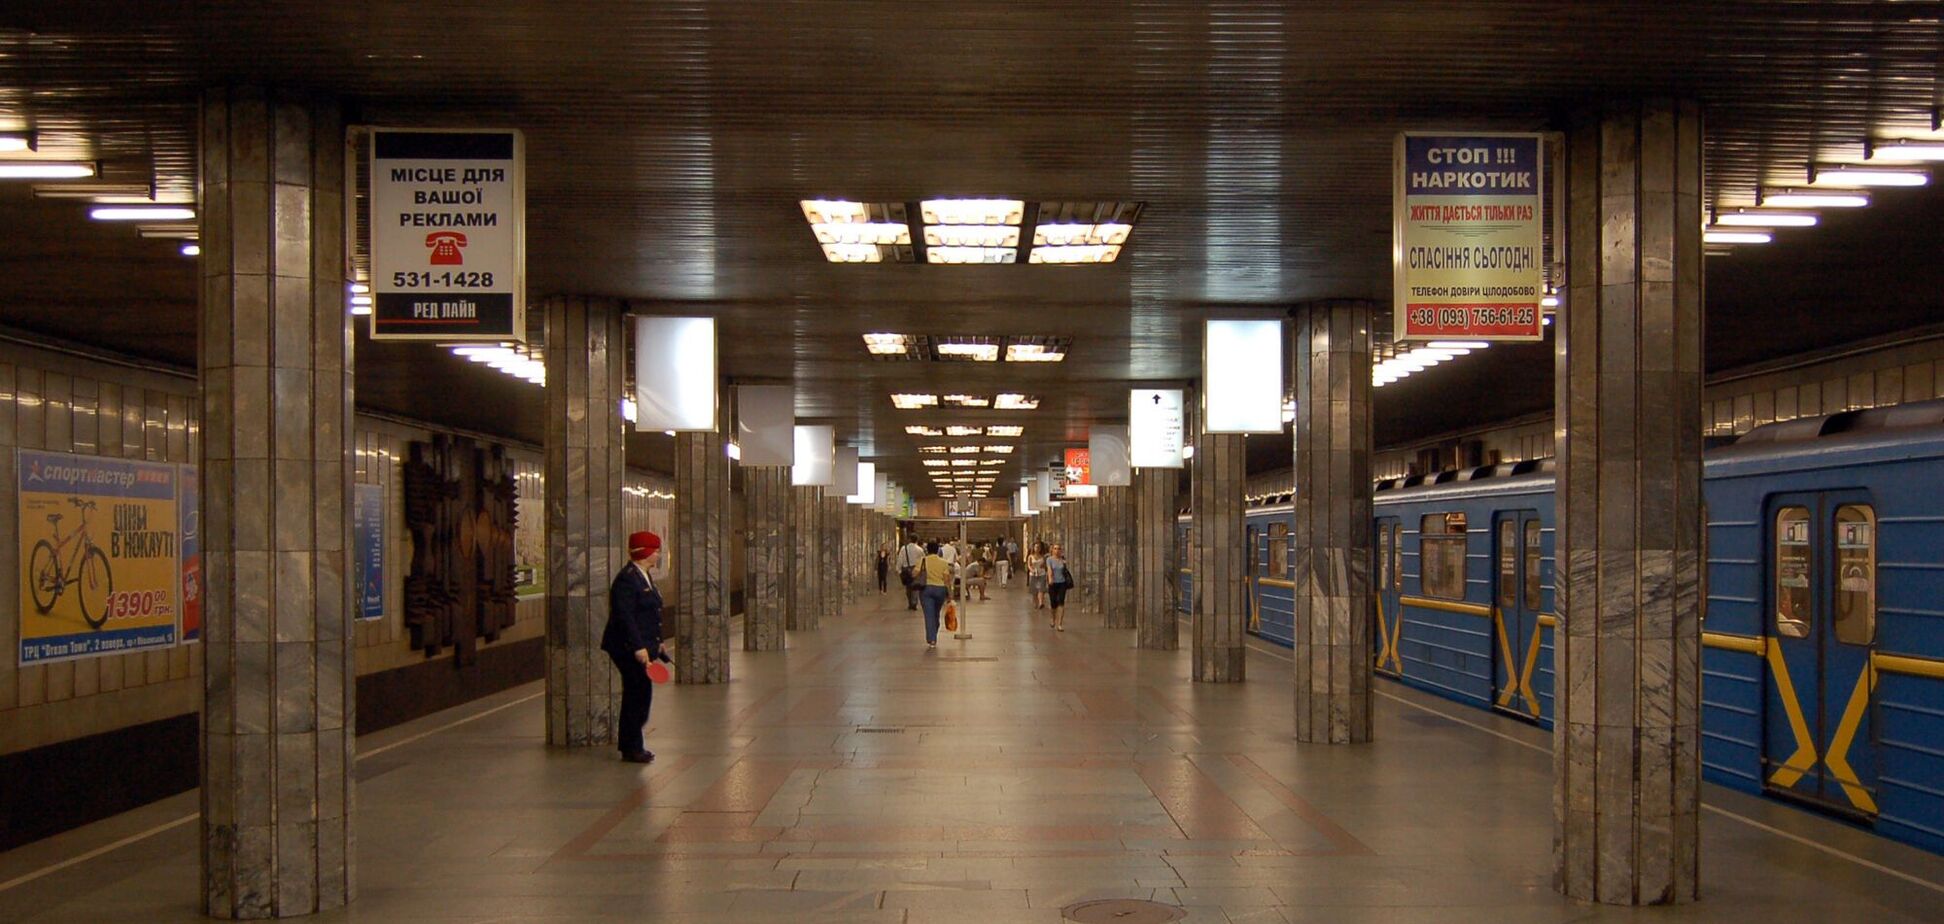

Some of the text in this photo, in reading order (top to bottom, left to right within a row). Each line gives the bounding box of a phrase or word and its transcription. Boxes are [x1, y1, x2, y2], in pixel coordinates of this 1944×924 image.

[1427, 148, 1515, 164] СТОП !!!
[391, 168, 504, 184] МІСЦЕ ДЛЯ
[1412, 172, 1530, 188] НАРКОТИК
[414, 188, 483, 204] ВАШОЇ
[400, 213, 497, 227] РЕКЛАМИ
[1410, 205, 1533, 223] ЖИТТЯ ДАЄТЬСЯ ТІЛЬКИ РАЗ
[1409, 247, 1534, 272] СПАСІННЯ СЬОГОДНІ
[393, 272, 494, 287] 531-1428
[1412, 287, 1535, 298] ТЕЛЕФОН ДОВІРИ ЦІЛОДОБОВО
[414, 300, 476, 319] РЕД ЛАЙН
[1411, 308, 1533, 328] +38 (093) 756-61-25
[111, 531, 173, 559] В НОКАУТІ
[107, 591, 153, 618] 1390
